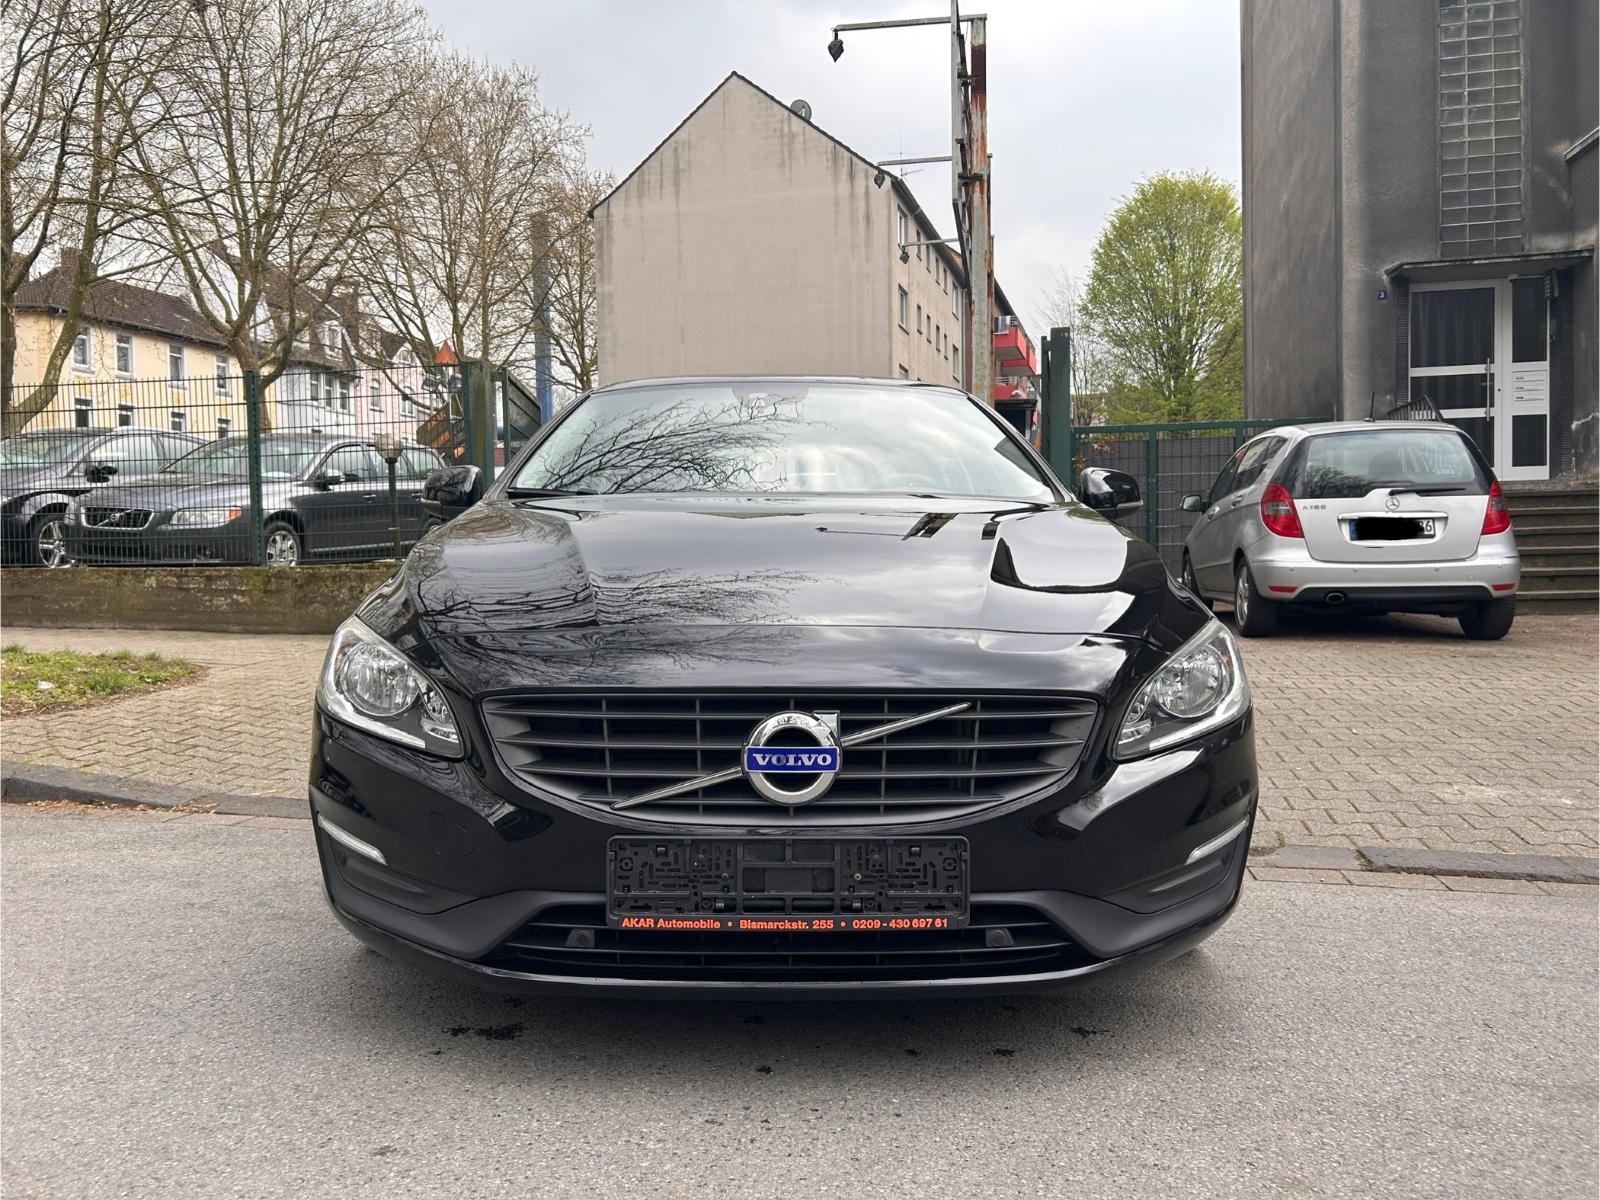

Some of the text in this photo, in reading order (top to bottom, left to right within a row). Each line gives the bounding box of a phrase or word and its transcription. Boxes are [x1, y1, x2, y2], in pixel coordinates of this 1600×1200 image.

[752, 753, 832, 766] VOLVO
[621, 917, 654, 929] AKAR
[657, 918, 721, 929] Automobile
[739, 919, 809, 930] Bismarckstr.
[812, 919, 834, 930] 255
[852, 919, 881, 929] 0209
[889, 919, 910, 929] 430
[911, 918, 933, 929] 697
[934, 918, 948, 928] 61
